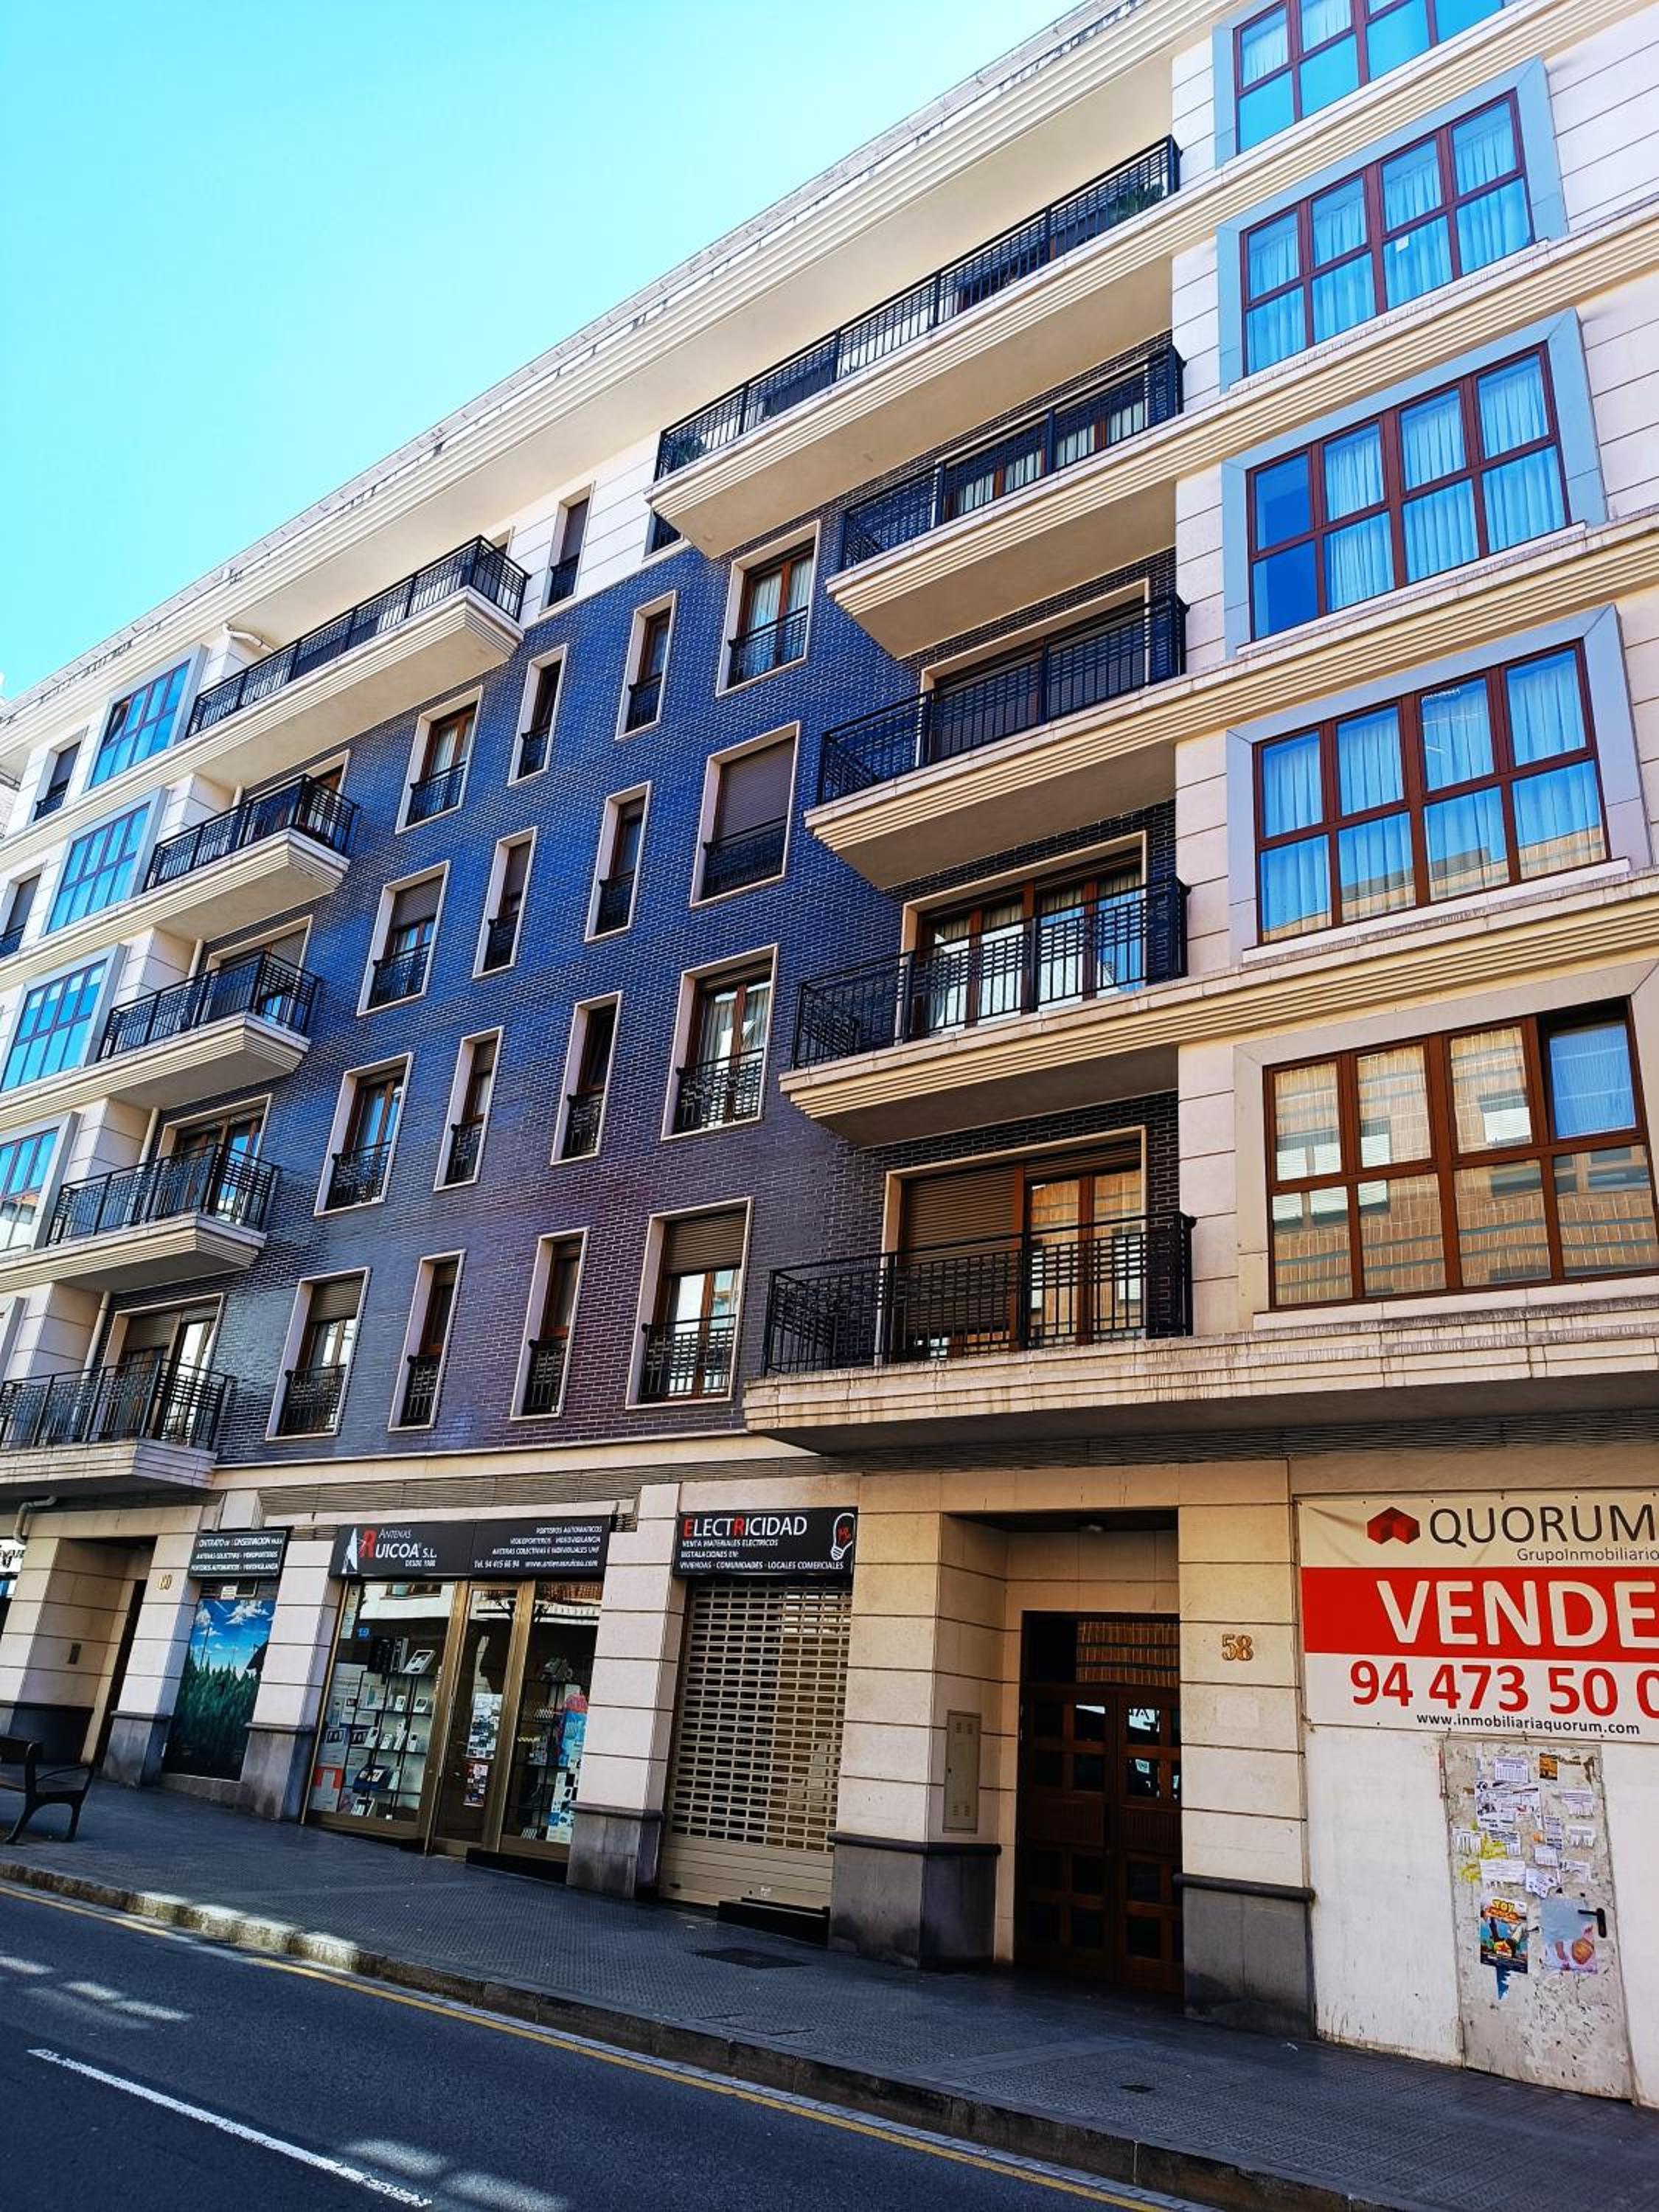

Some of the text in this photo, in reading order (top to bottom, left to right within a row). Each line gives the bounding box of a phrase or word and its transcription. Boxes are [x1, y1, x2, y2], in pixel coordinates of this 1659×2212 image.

[683, 1516, 808, 1538] ELECTRICIDAD
[1429, 1504, 1657, 1548] QUORUM
[797, 1561, 844, 1570] COMERCIALES
[1376, 1580, 1659, 1649] VENDE
[1222, 1634, 1254, 1660] 58
[1349, 1660, 1413, 1707] 94
[1428, 1663, 1529, 1712] 473
[1548, 1666, 1618, 1717] 50
[1416, 1712, 1641, 1736] www.inmobiliariaquorum.com
